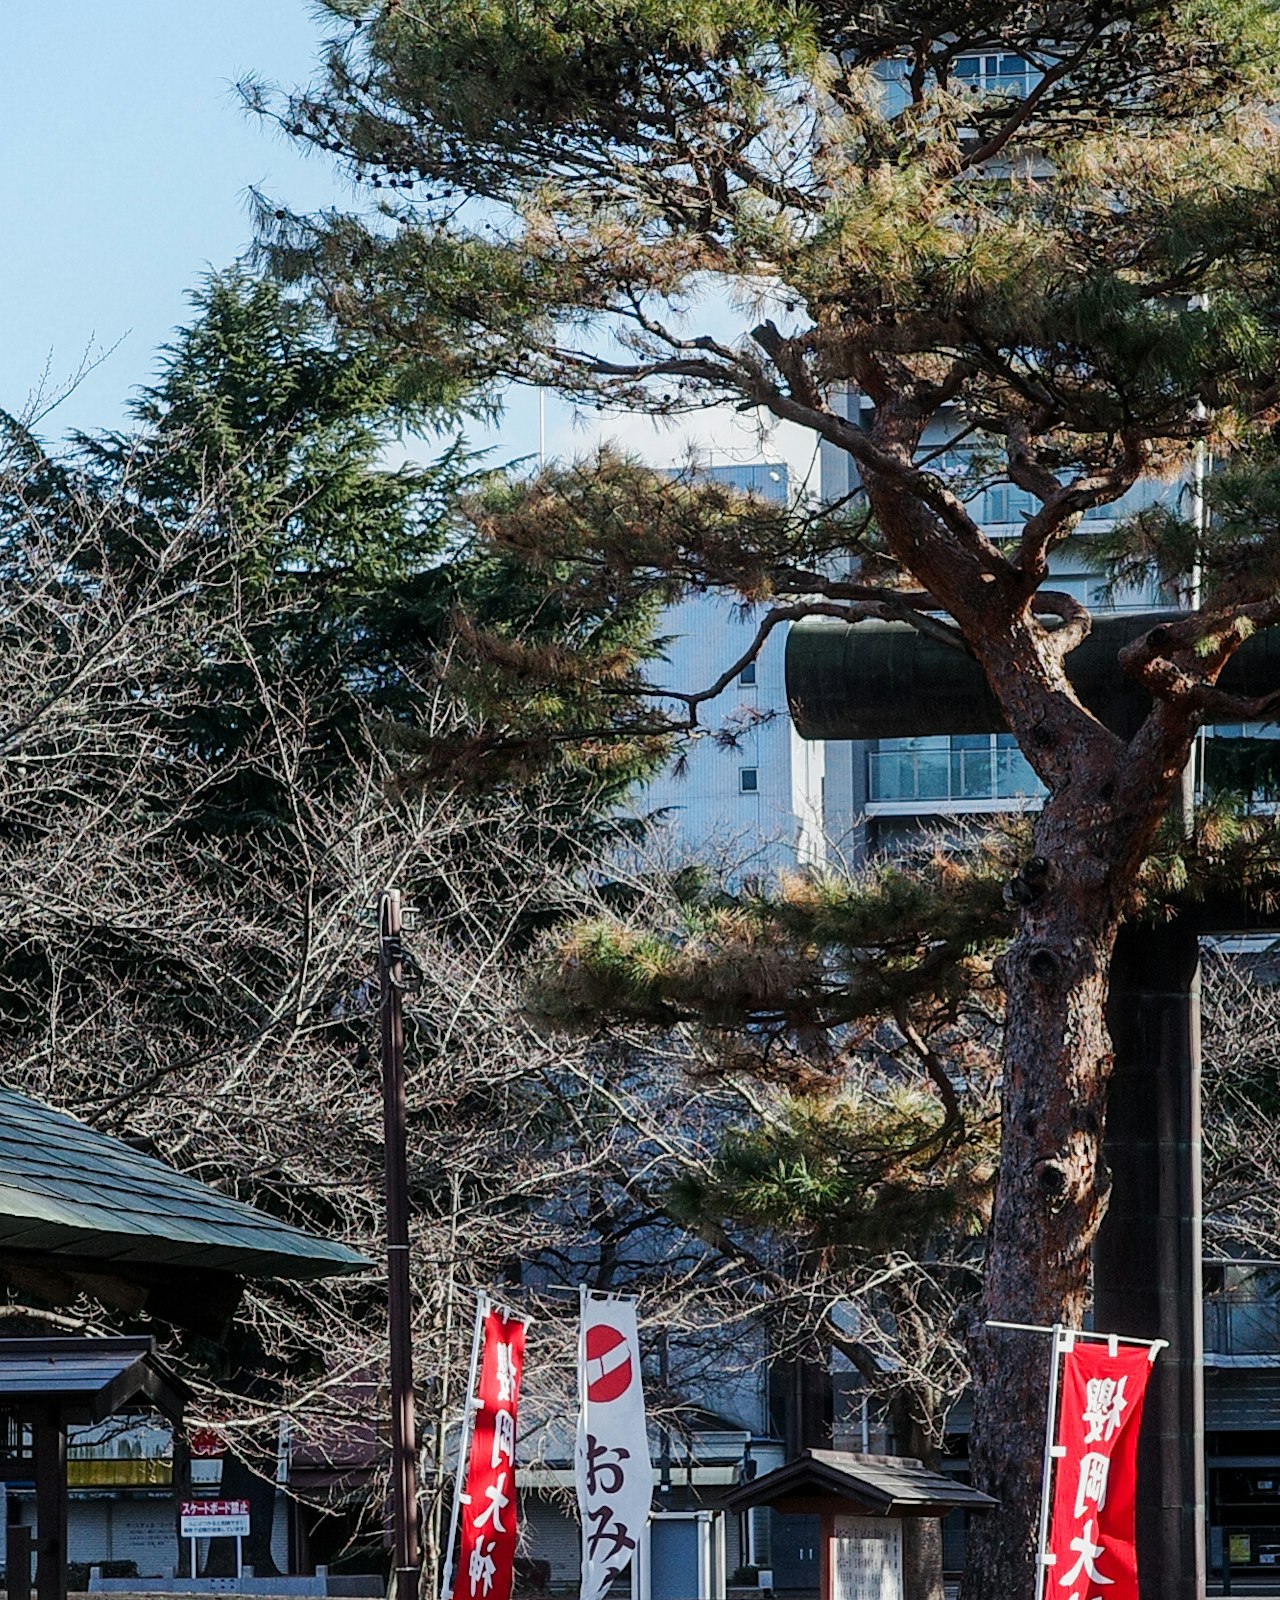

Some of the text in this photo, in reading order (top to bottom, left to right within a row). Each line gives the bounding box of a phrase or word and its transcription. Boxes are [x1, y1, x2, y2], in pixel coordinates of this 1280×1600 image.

[181, 1501, 249, 1515] スケートボード禁止
